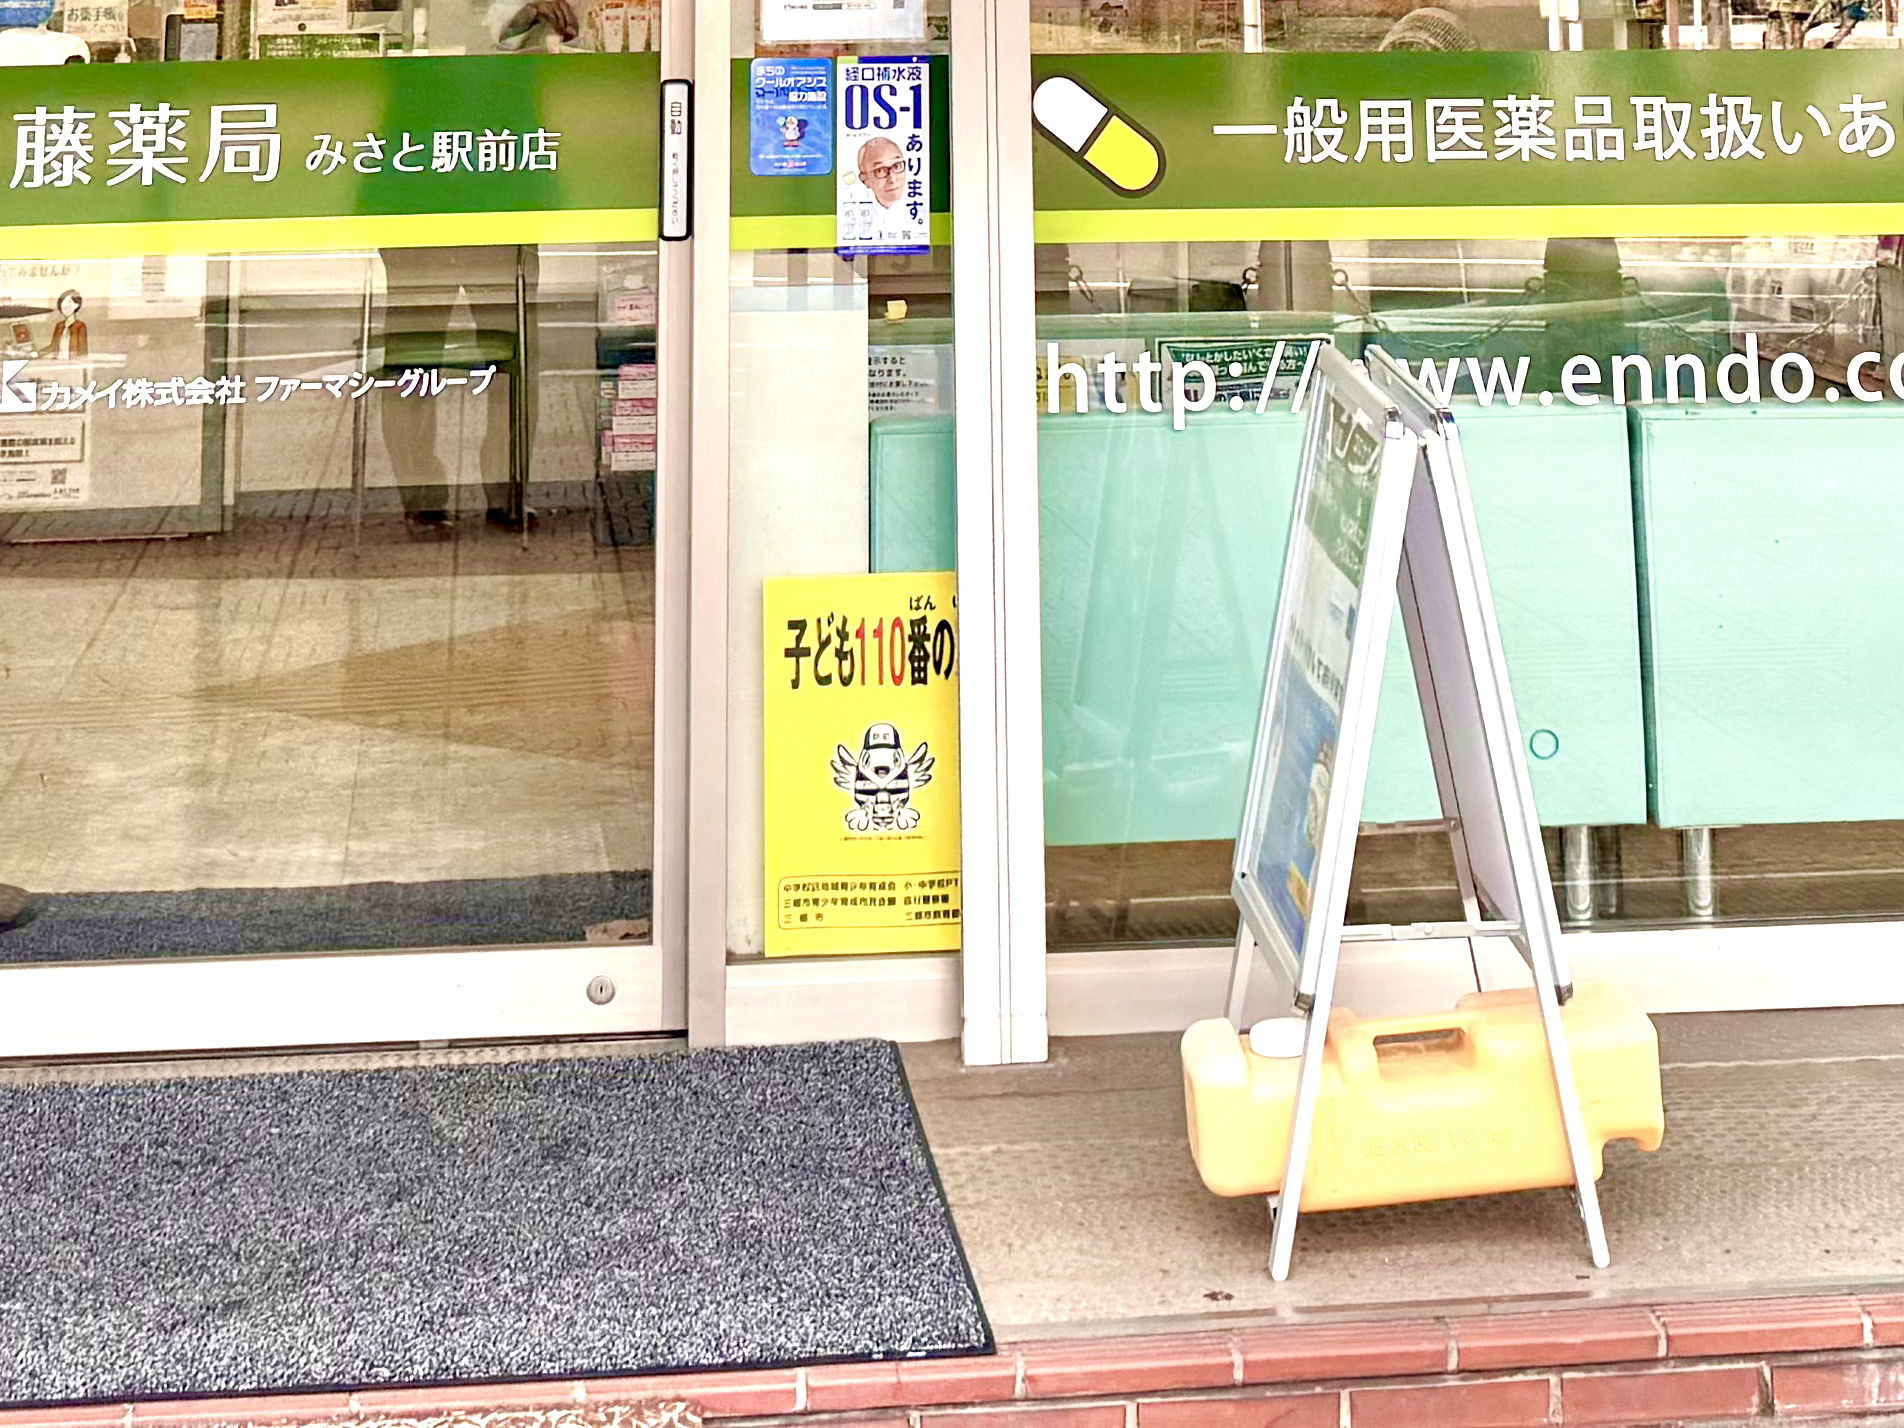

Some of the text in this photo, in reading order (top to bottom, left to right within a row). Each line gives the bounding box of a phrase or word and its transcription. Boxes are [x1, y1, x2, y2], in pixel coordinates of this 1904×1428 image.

[845, 66, 922, 82] 経口補水液
[845, 83, 922, 130] OS-1
[304, 127, 563, 176] みさと駅前店
[905, 133, 924, 226] あります。
[39, 364, 496, 412] カメイ株式会社 ファーマシーグループ
